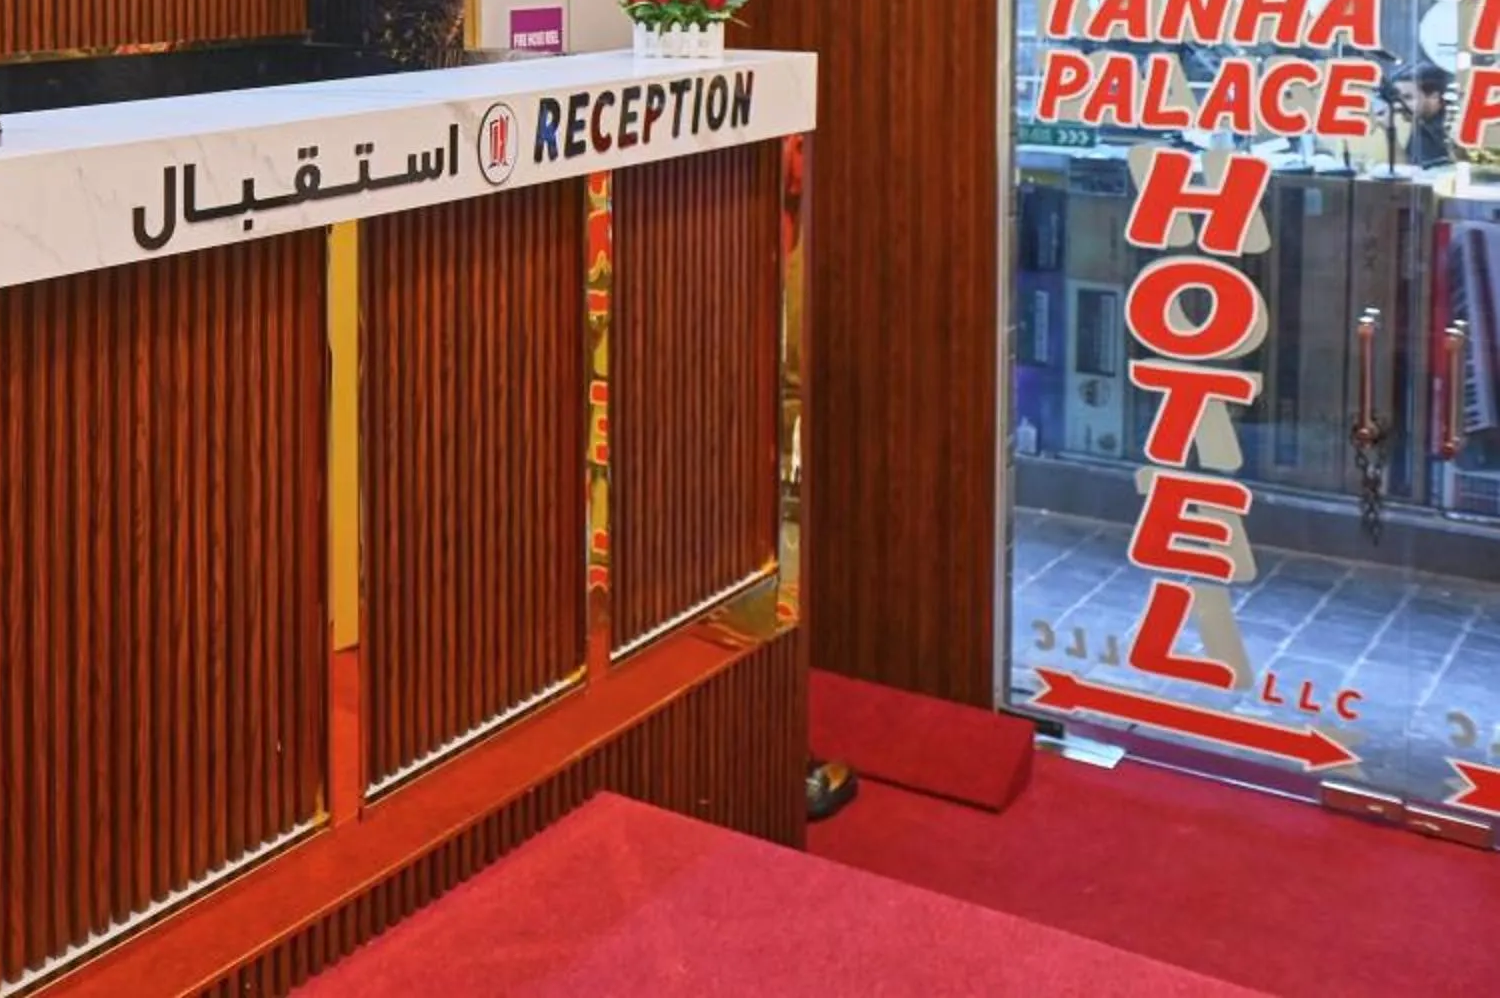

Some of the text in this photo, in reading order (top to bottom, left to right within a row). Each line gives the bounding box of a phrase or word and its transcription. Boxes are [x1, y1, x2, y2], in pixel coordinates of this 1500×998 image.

[533, 70, 755, 163] RECEPTION
[1037, 49, 1382, 137] PALACE
[132, 124, 459, 251] استقبال
[1124, 146, 1272, 692] HOTEL
[1262, 673, 1364, 720] LLC
